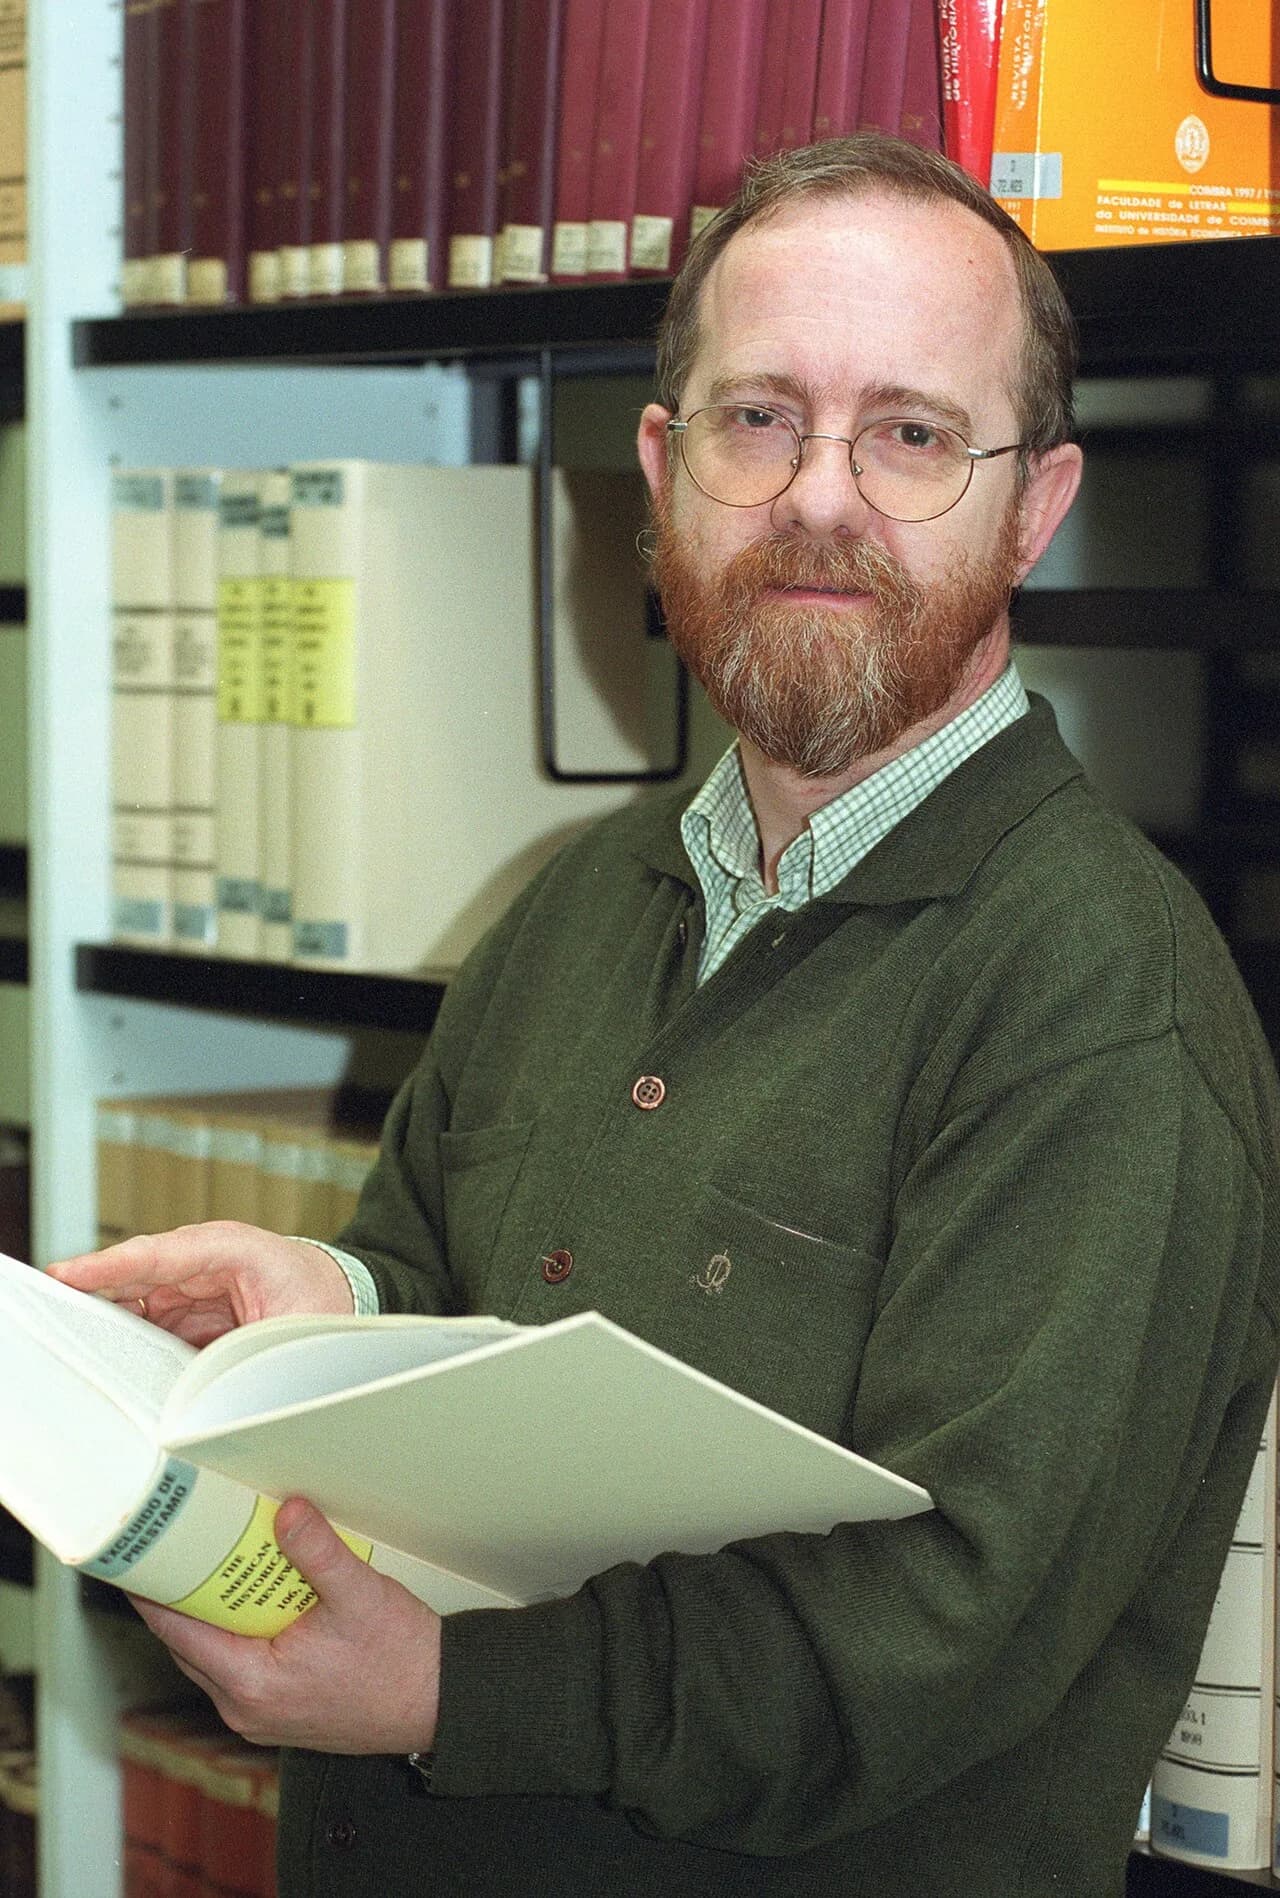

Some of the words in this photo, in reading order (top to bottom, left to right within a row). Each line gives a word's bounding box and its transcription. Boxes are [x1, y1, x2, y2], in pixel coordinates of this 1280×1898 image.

[943, 35, 952, 101] REVISTA
[1011, 35, 1021, 101] REVISTA
[1096, 196, 1162, 209] FACULDADE
[1168, 199, 1183, 210] de
[1189, 201, 1227, 212] LETRAS
[1118, 211, 1200, 224] UNIVERSIDADE
[1206, 215, 1223, 225] de
[98, 1498, 162, 1565] EXCLUIDO
[158, 1472, 177, 1495] DE
[219, 1541, 272, 1602] AMERICAN
[221, 1554, 246, 1579] THE
[228, 1550, 282, 1611] HISTORICA
[254, 1562, 293, 1606] REVIEW
[294, 1589, 318, 1613] 200
